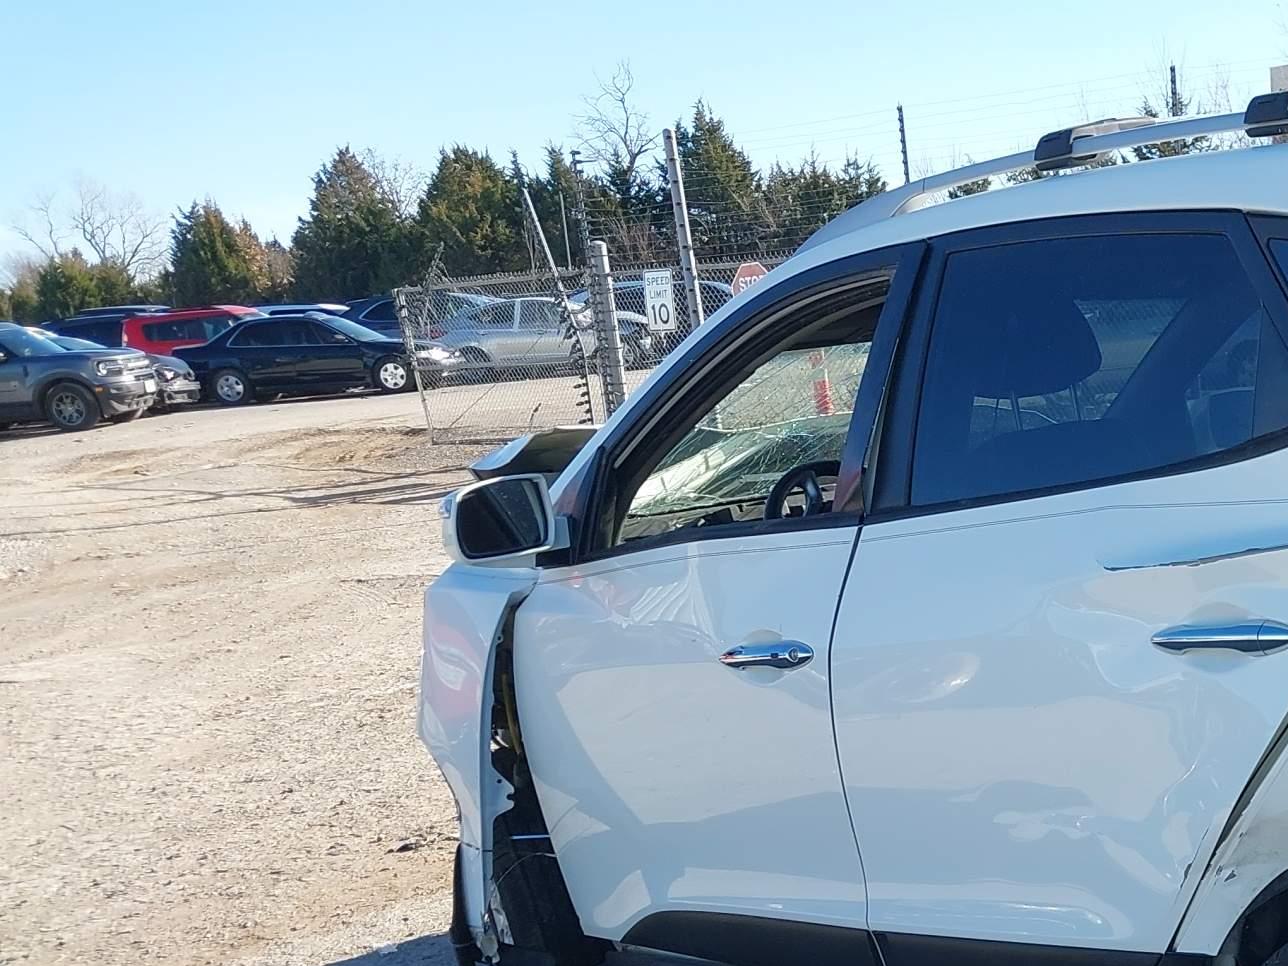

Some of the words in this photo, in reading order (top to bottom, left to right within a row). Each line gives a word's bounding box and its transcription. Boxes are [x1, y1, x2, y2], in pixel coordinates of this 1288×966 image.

[646, 276, 670, 286] SPEED
[738, 275, 764, 291] STO
[649, 289, 668, 300] LIMIT
[650, 302, 671, 325] 10
